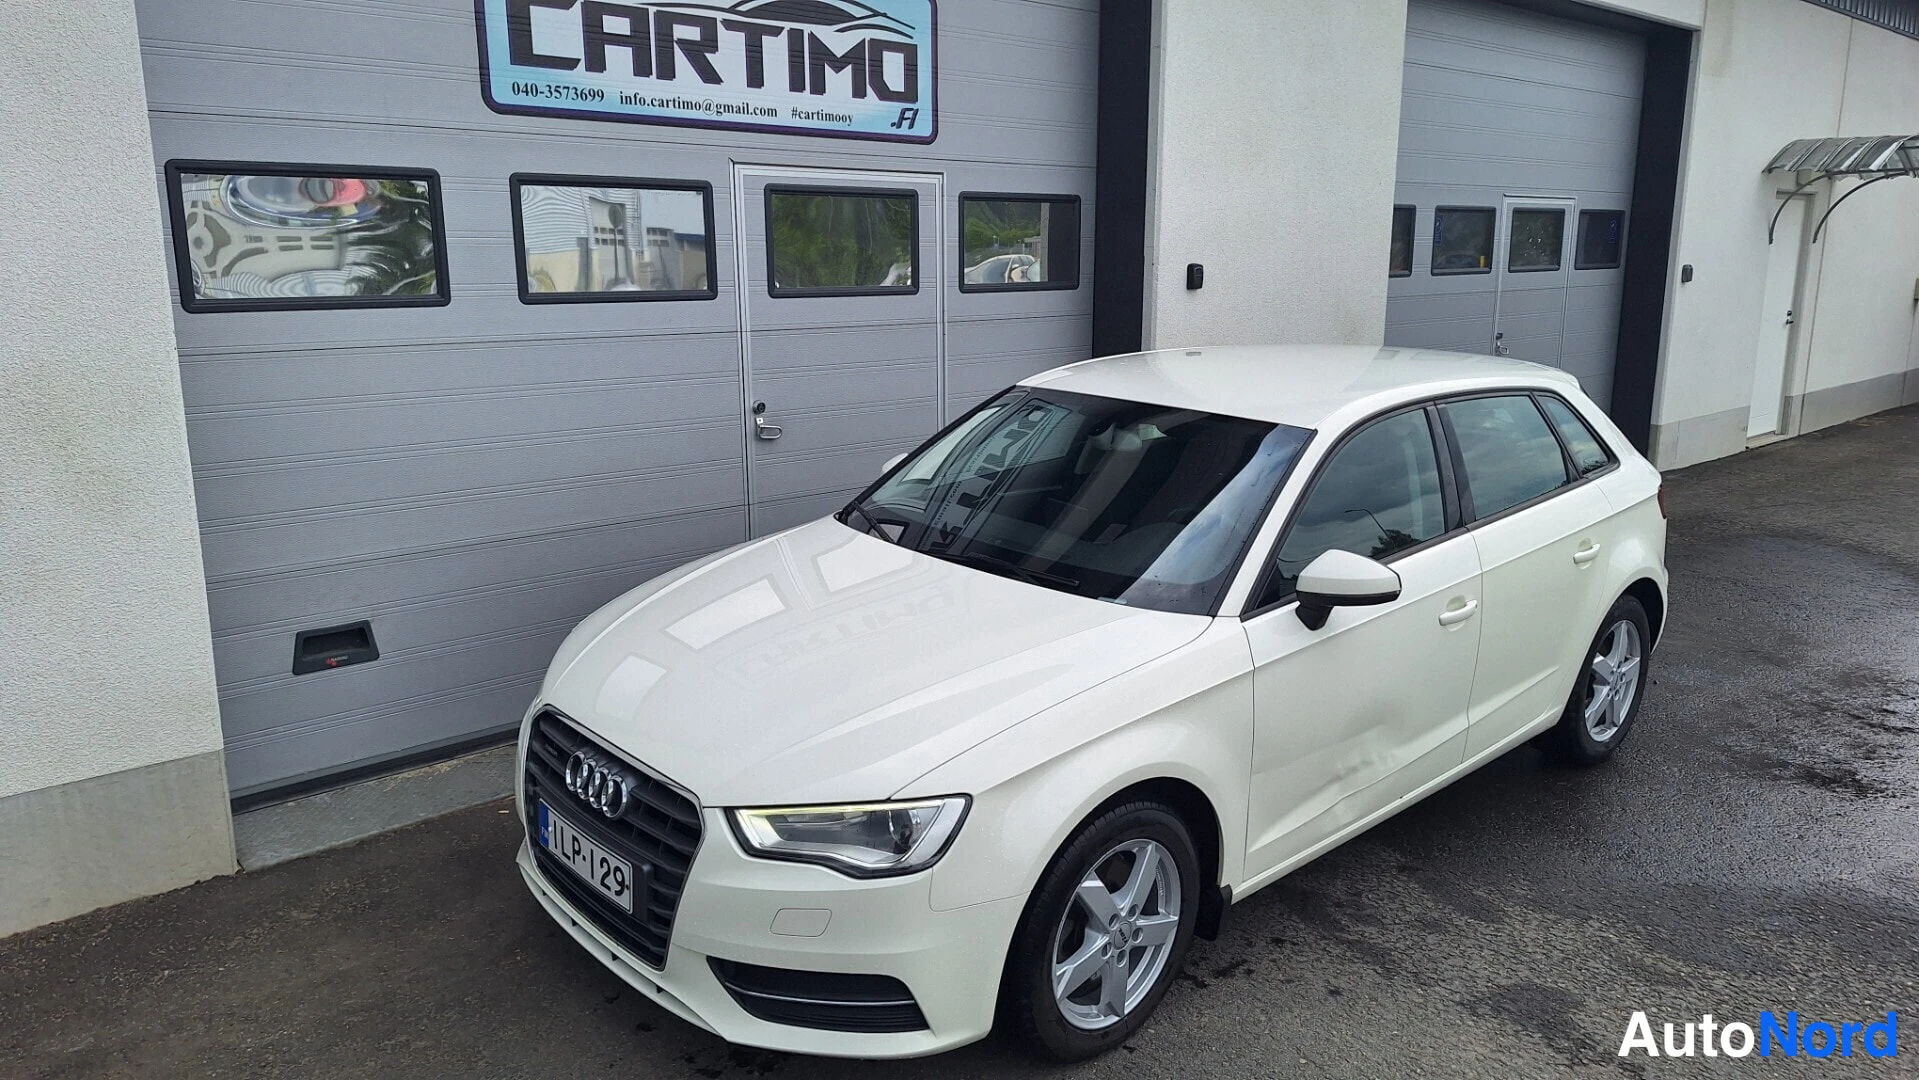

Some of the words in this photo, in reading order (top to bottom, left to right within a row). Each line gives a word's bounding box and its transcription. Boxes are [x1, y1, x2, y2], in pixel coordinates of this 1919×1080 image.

[508, 0, 919, 103] CARTIMO
[511, 81, 605, 103] 040-3573699
[619, 90, 778, 119] info.cartimo@gmail.com
[790, 106, 854, 126] #cartimooy
[552, 819, 626, 896] ILP-129
